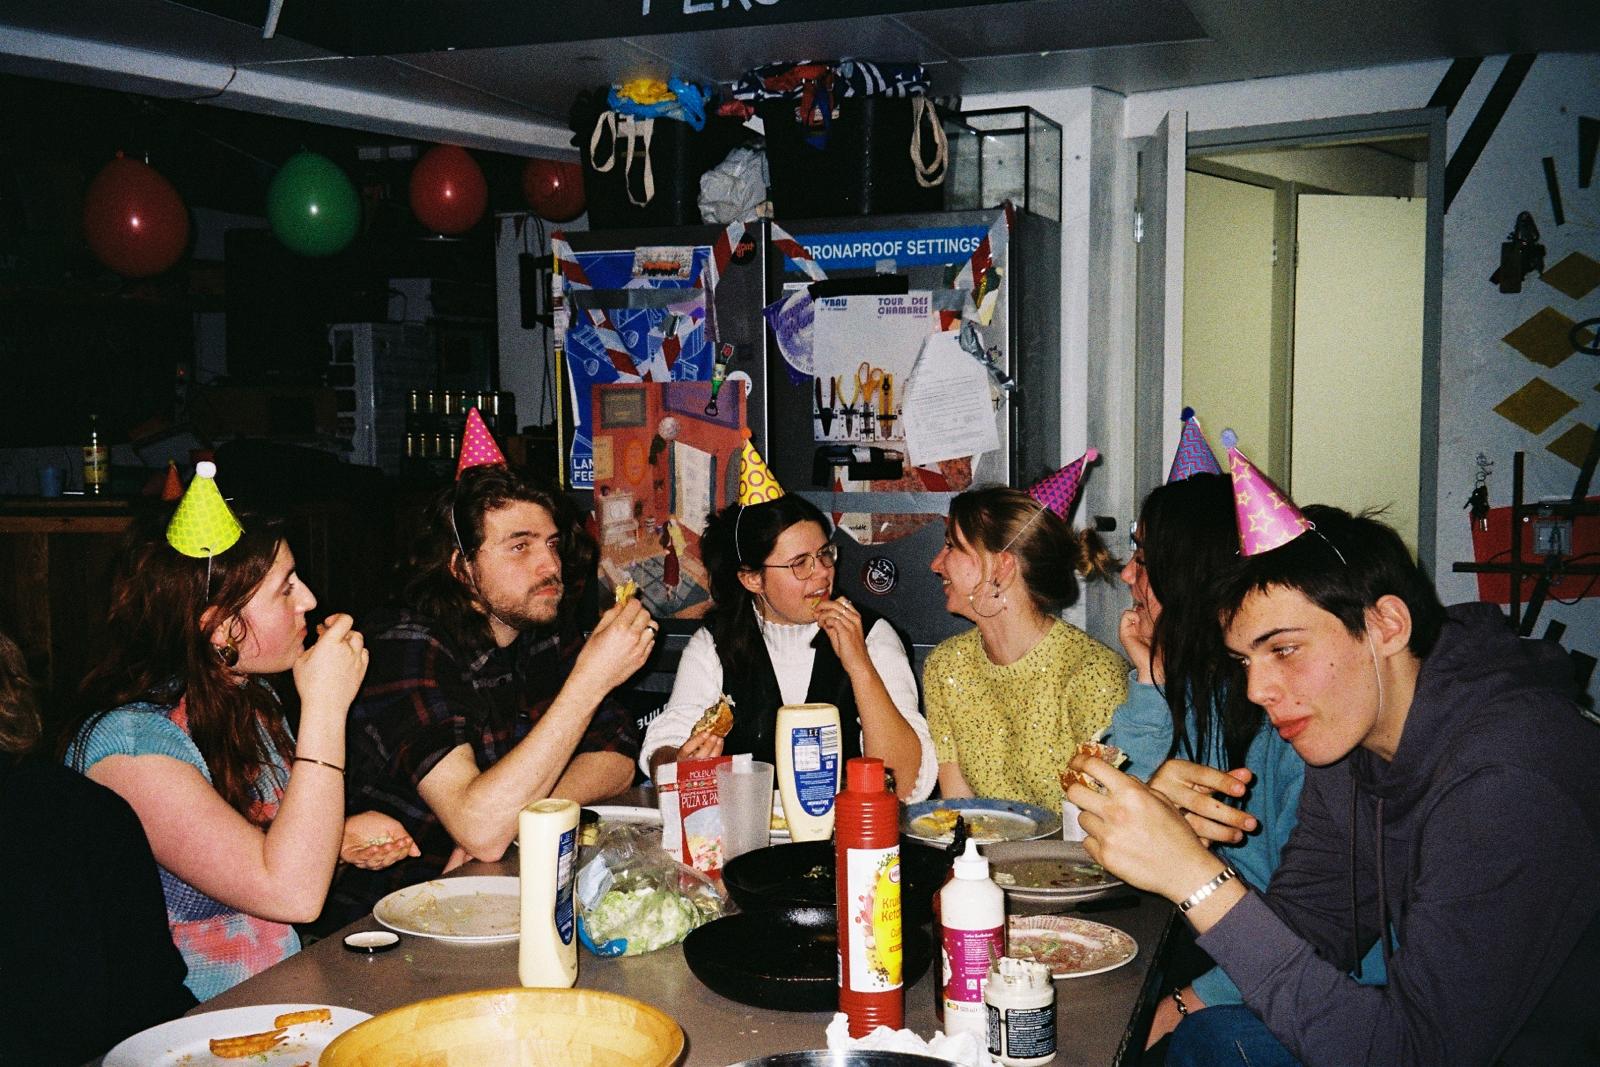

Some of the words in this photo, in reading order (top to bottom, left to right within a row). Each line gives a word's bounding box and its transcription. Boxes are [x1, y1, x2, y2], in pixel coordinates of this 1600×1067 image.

[803, 241, 902, 259] RONAPROOF
[907, 237, 980, 254] SETTINGS
[912, 297, 928, 305] DES
[878, 306, 928, 314] CHAMBRES
[681, 795, 701, 808] PIZZA
[702, 795, 709, 806] &
[882, 895, 901, 909] Krui
[881, 910, 901, 922] Ketc
